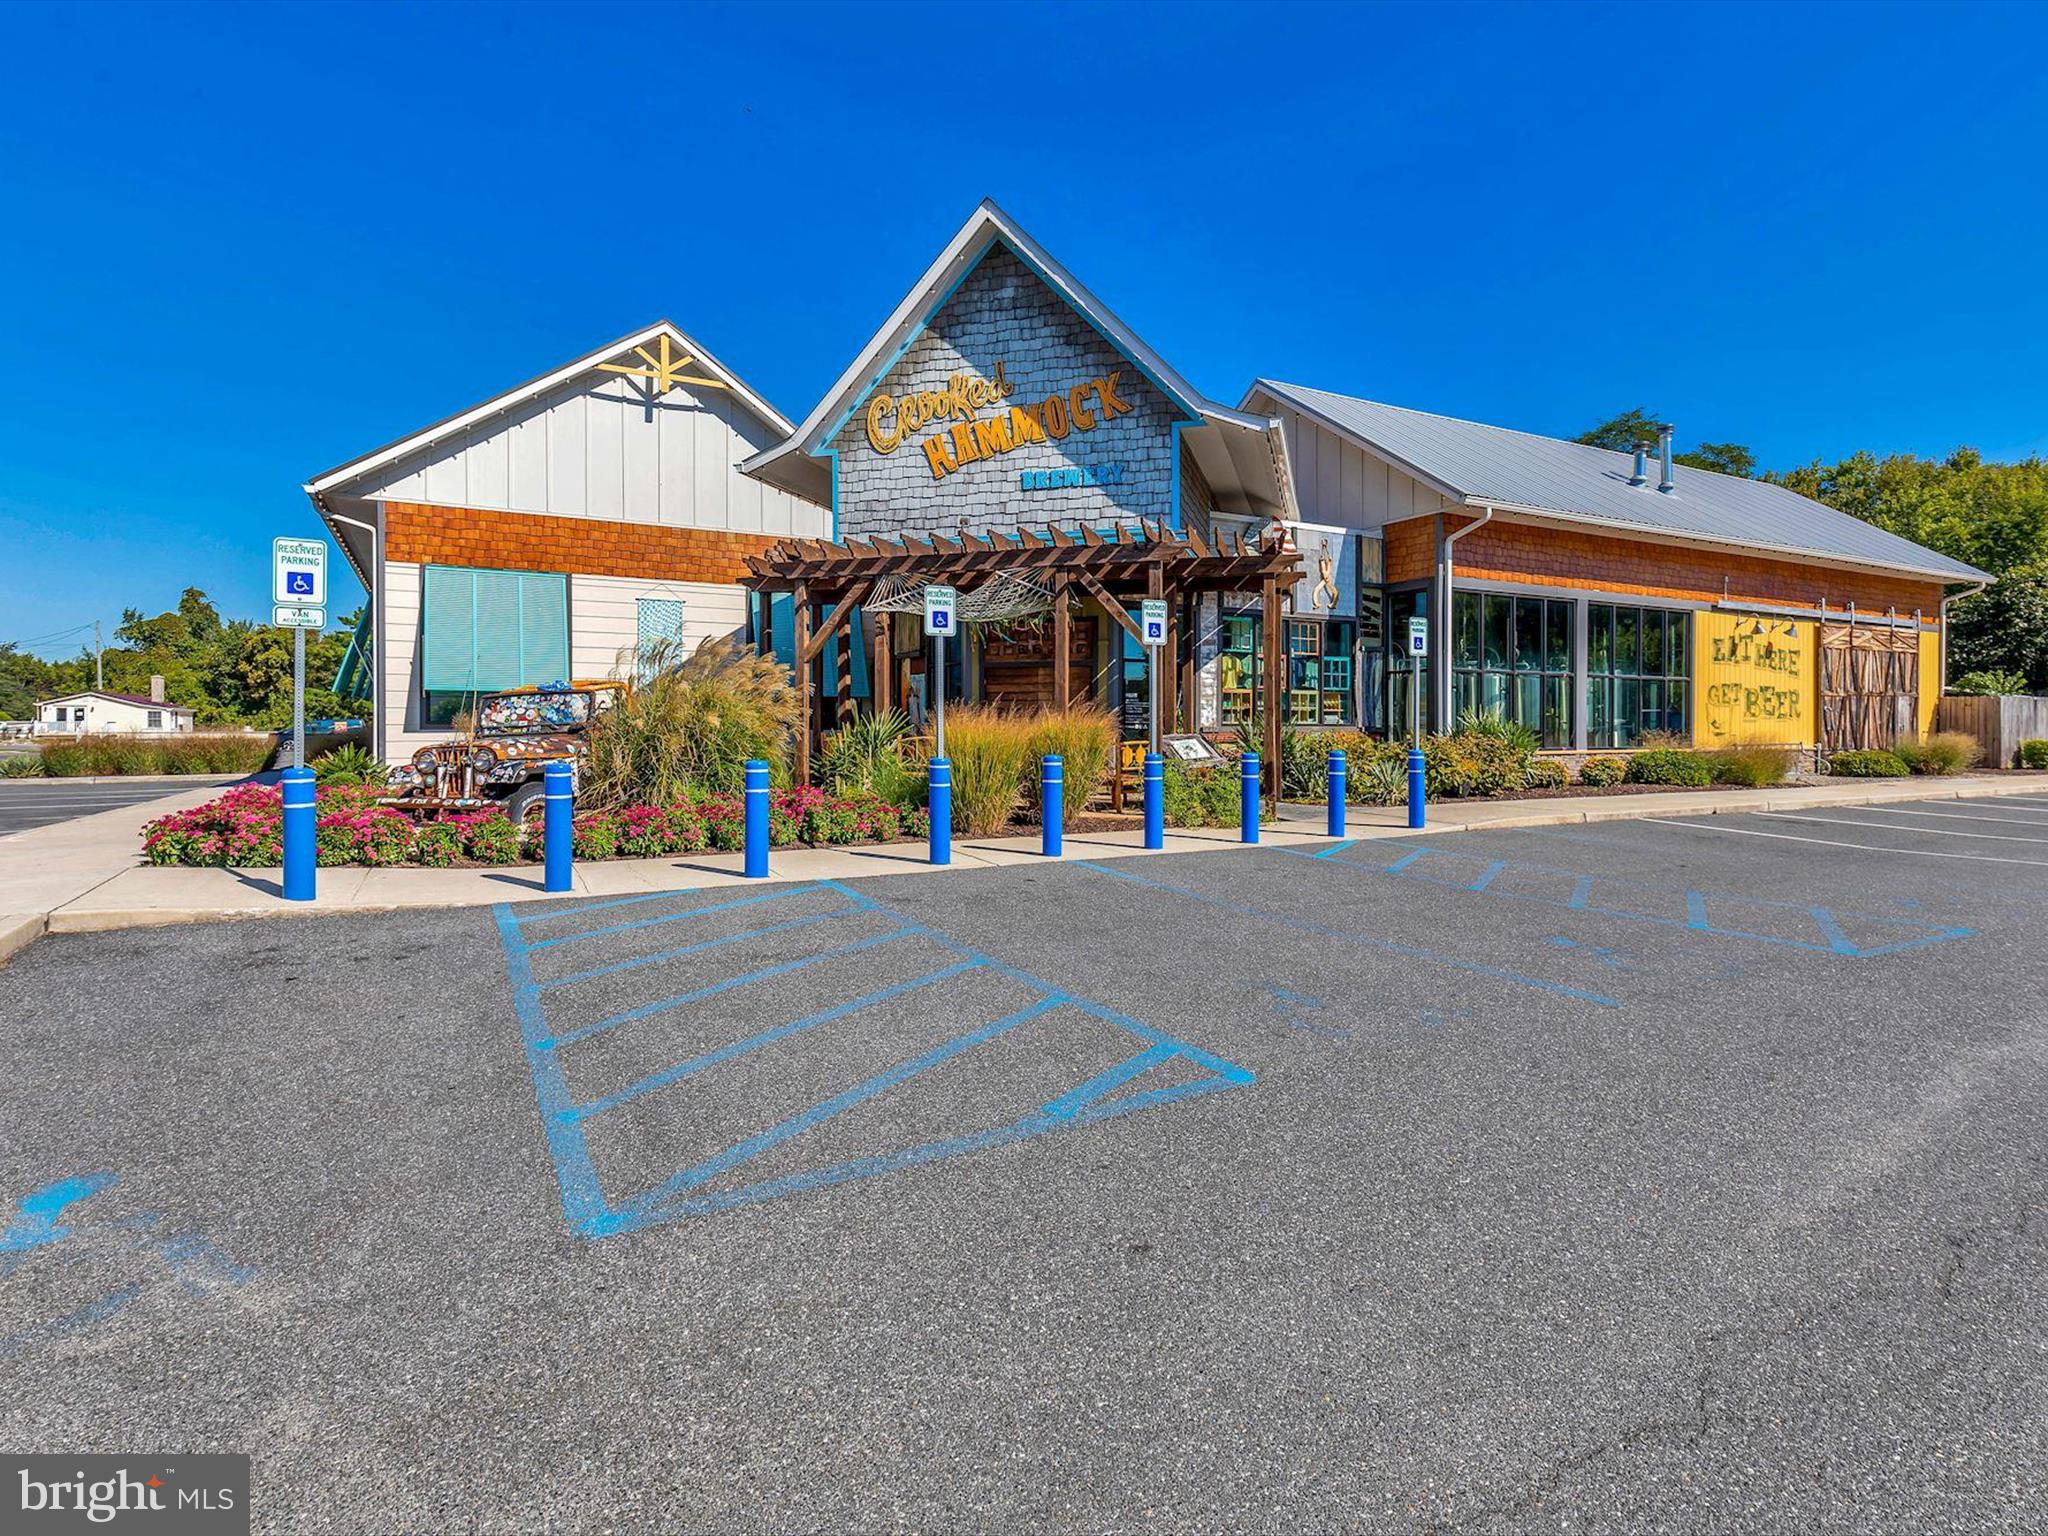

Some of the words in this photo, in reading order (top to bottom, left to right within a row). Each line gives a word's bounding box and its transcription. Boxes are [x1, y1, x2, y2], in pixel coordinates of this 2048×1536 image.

[921, 370, 1134, 480] HAMMOCK
[1020, 464, 1126, 491] BREWERY
[277, 543, 323, 556] RESERVED
[281, 555, 320, 567] PARKING
[927, 590, 953, 598] RESERVED
[291, 610, 310, 618] VAN
[1712, 634, 1754, 664] EAT
[1755, 641, 1801, 677] HERE
[1707, 683, 1742, 705] GET
[1744, 685, 1801, 720] BEER
